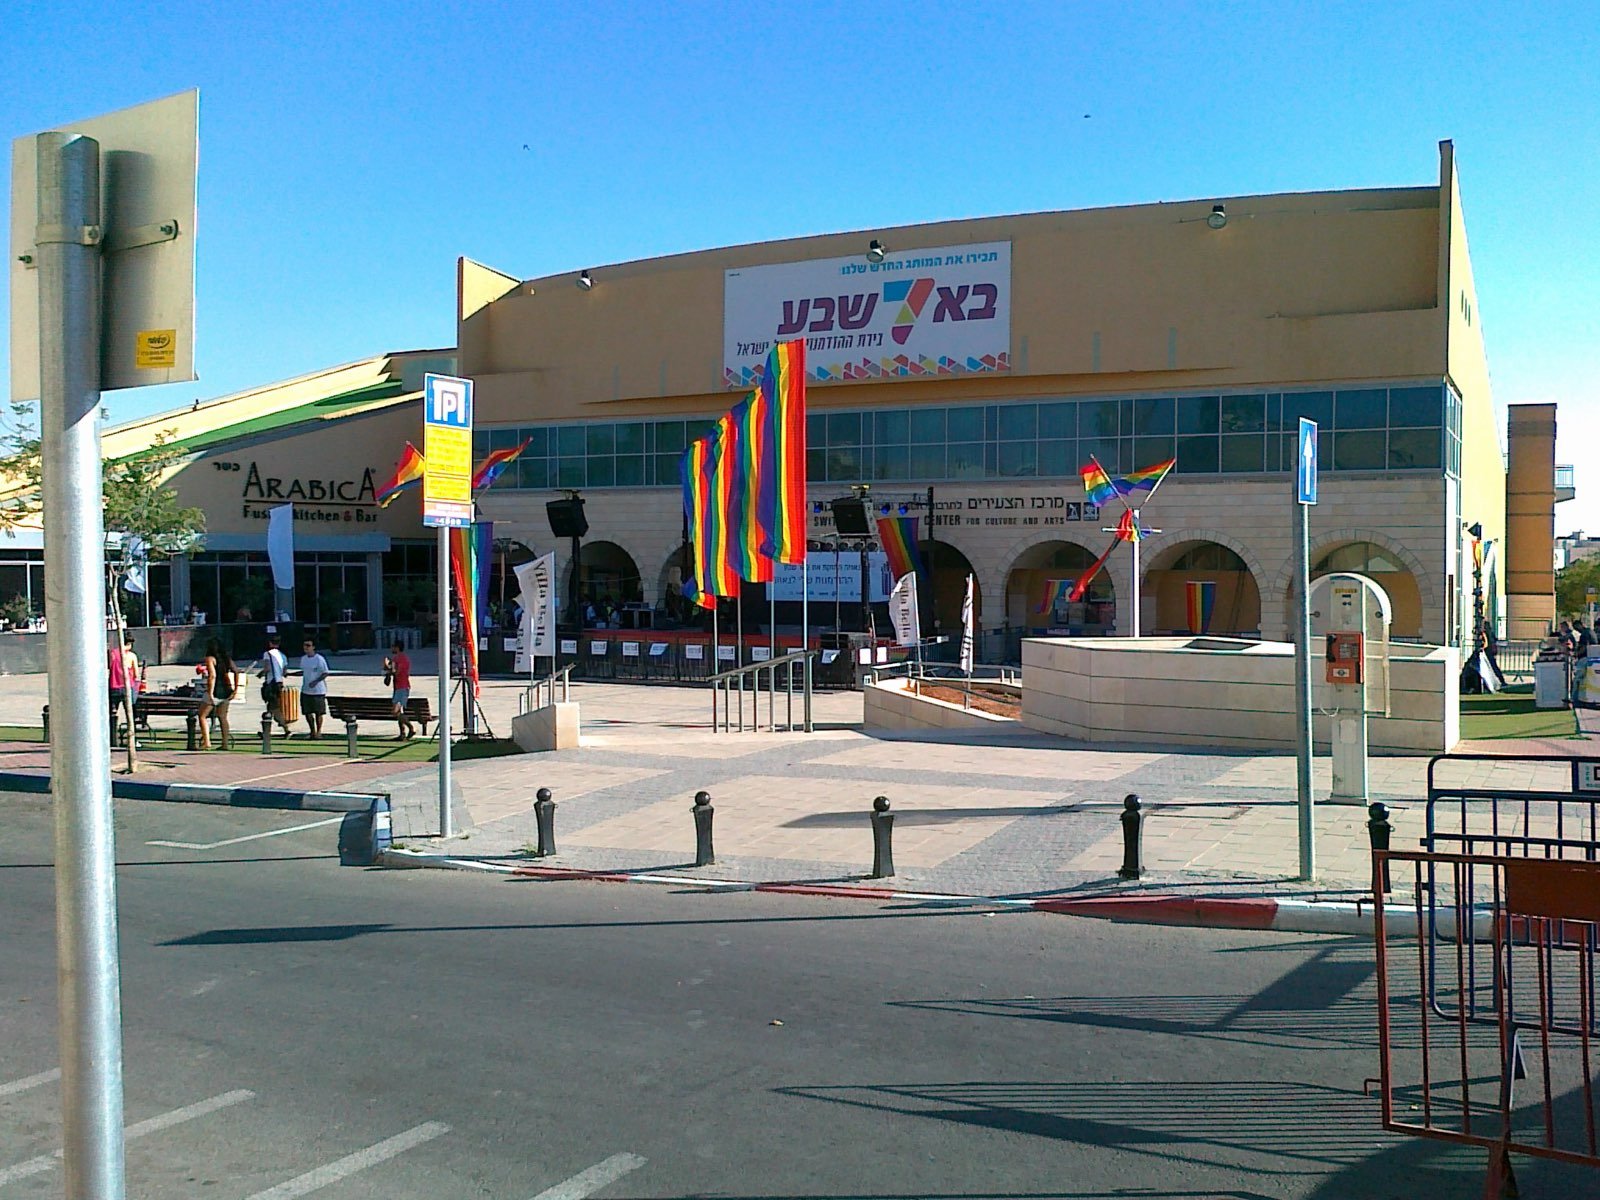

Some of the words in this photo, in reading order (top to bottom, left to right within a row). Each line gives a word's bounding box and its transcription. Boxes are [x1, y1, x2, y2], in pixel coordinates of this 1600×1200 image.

[870, 259, 904, 272] החדש
[905, 256, 943, 270] המותג
[945, 255, 965, 266] את
[841, 262, 868, 275] שלנו
[777, 292, 880, 335] שבע
[806, 334, 853, 352] ההזדמנוי
[857, 332, 883, 348] בירת
[736, 342, 769, 356] ישראל
[443, 392, 457, 421] P
[213, 461, 240, 472] כשר
[931, 500, 964, 511] לתרבו
[967, 497, 1025, 509] הצעירים
[1030, 496, 1065, 509] מרכז
[966, 517, 980, 526] FOR
[1022, 517, 1038, 526] AND
[1043, 517, 1065, 526] ARTS
